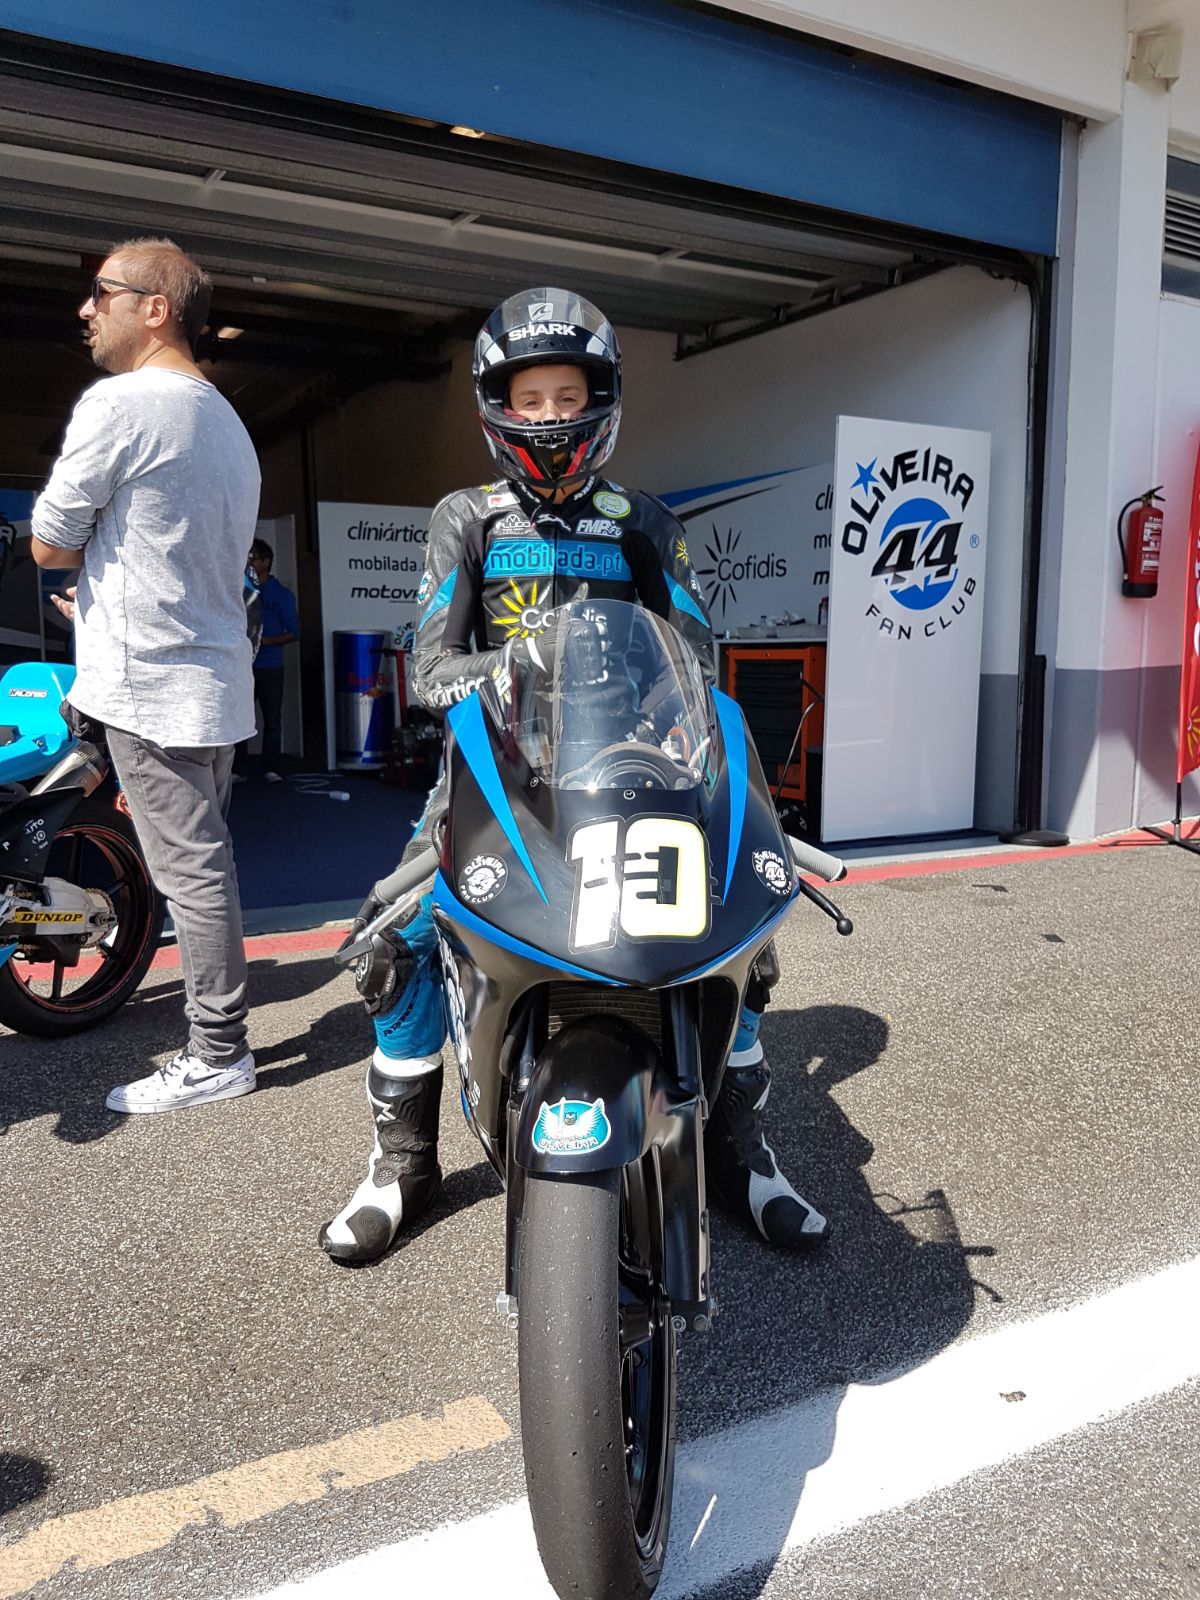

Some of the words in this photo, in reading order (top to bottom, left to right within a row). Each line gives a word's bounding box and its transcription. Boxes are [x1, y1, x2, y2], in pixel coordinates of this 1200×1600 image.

[508, 323, 577, 342] SHARK
[841, 447, 974, 556] OLIVEIRA
[490, 544, 623, 576] mobilada.pt
[870, 521, 965, 579] 44
[348, 555, 425, 572] mobilada.
[717, 552, 788, 583] Cofidis
[864, 602, 913, 641] FAN
[923, 576, 977, 638] CLUB
[464, 857, 506, 879] OLIVEIRA
[755, 850, 784, 873] OLIVEIRA
[765, 866, 786, 881] 44
[21, 913, 82, 922] DUNLOP
[538, 1136, 599, 1151] OLIVEIRA
